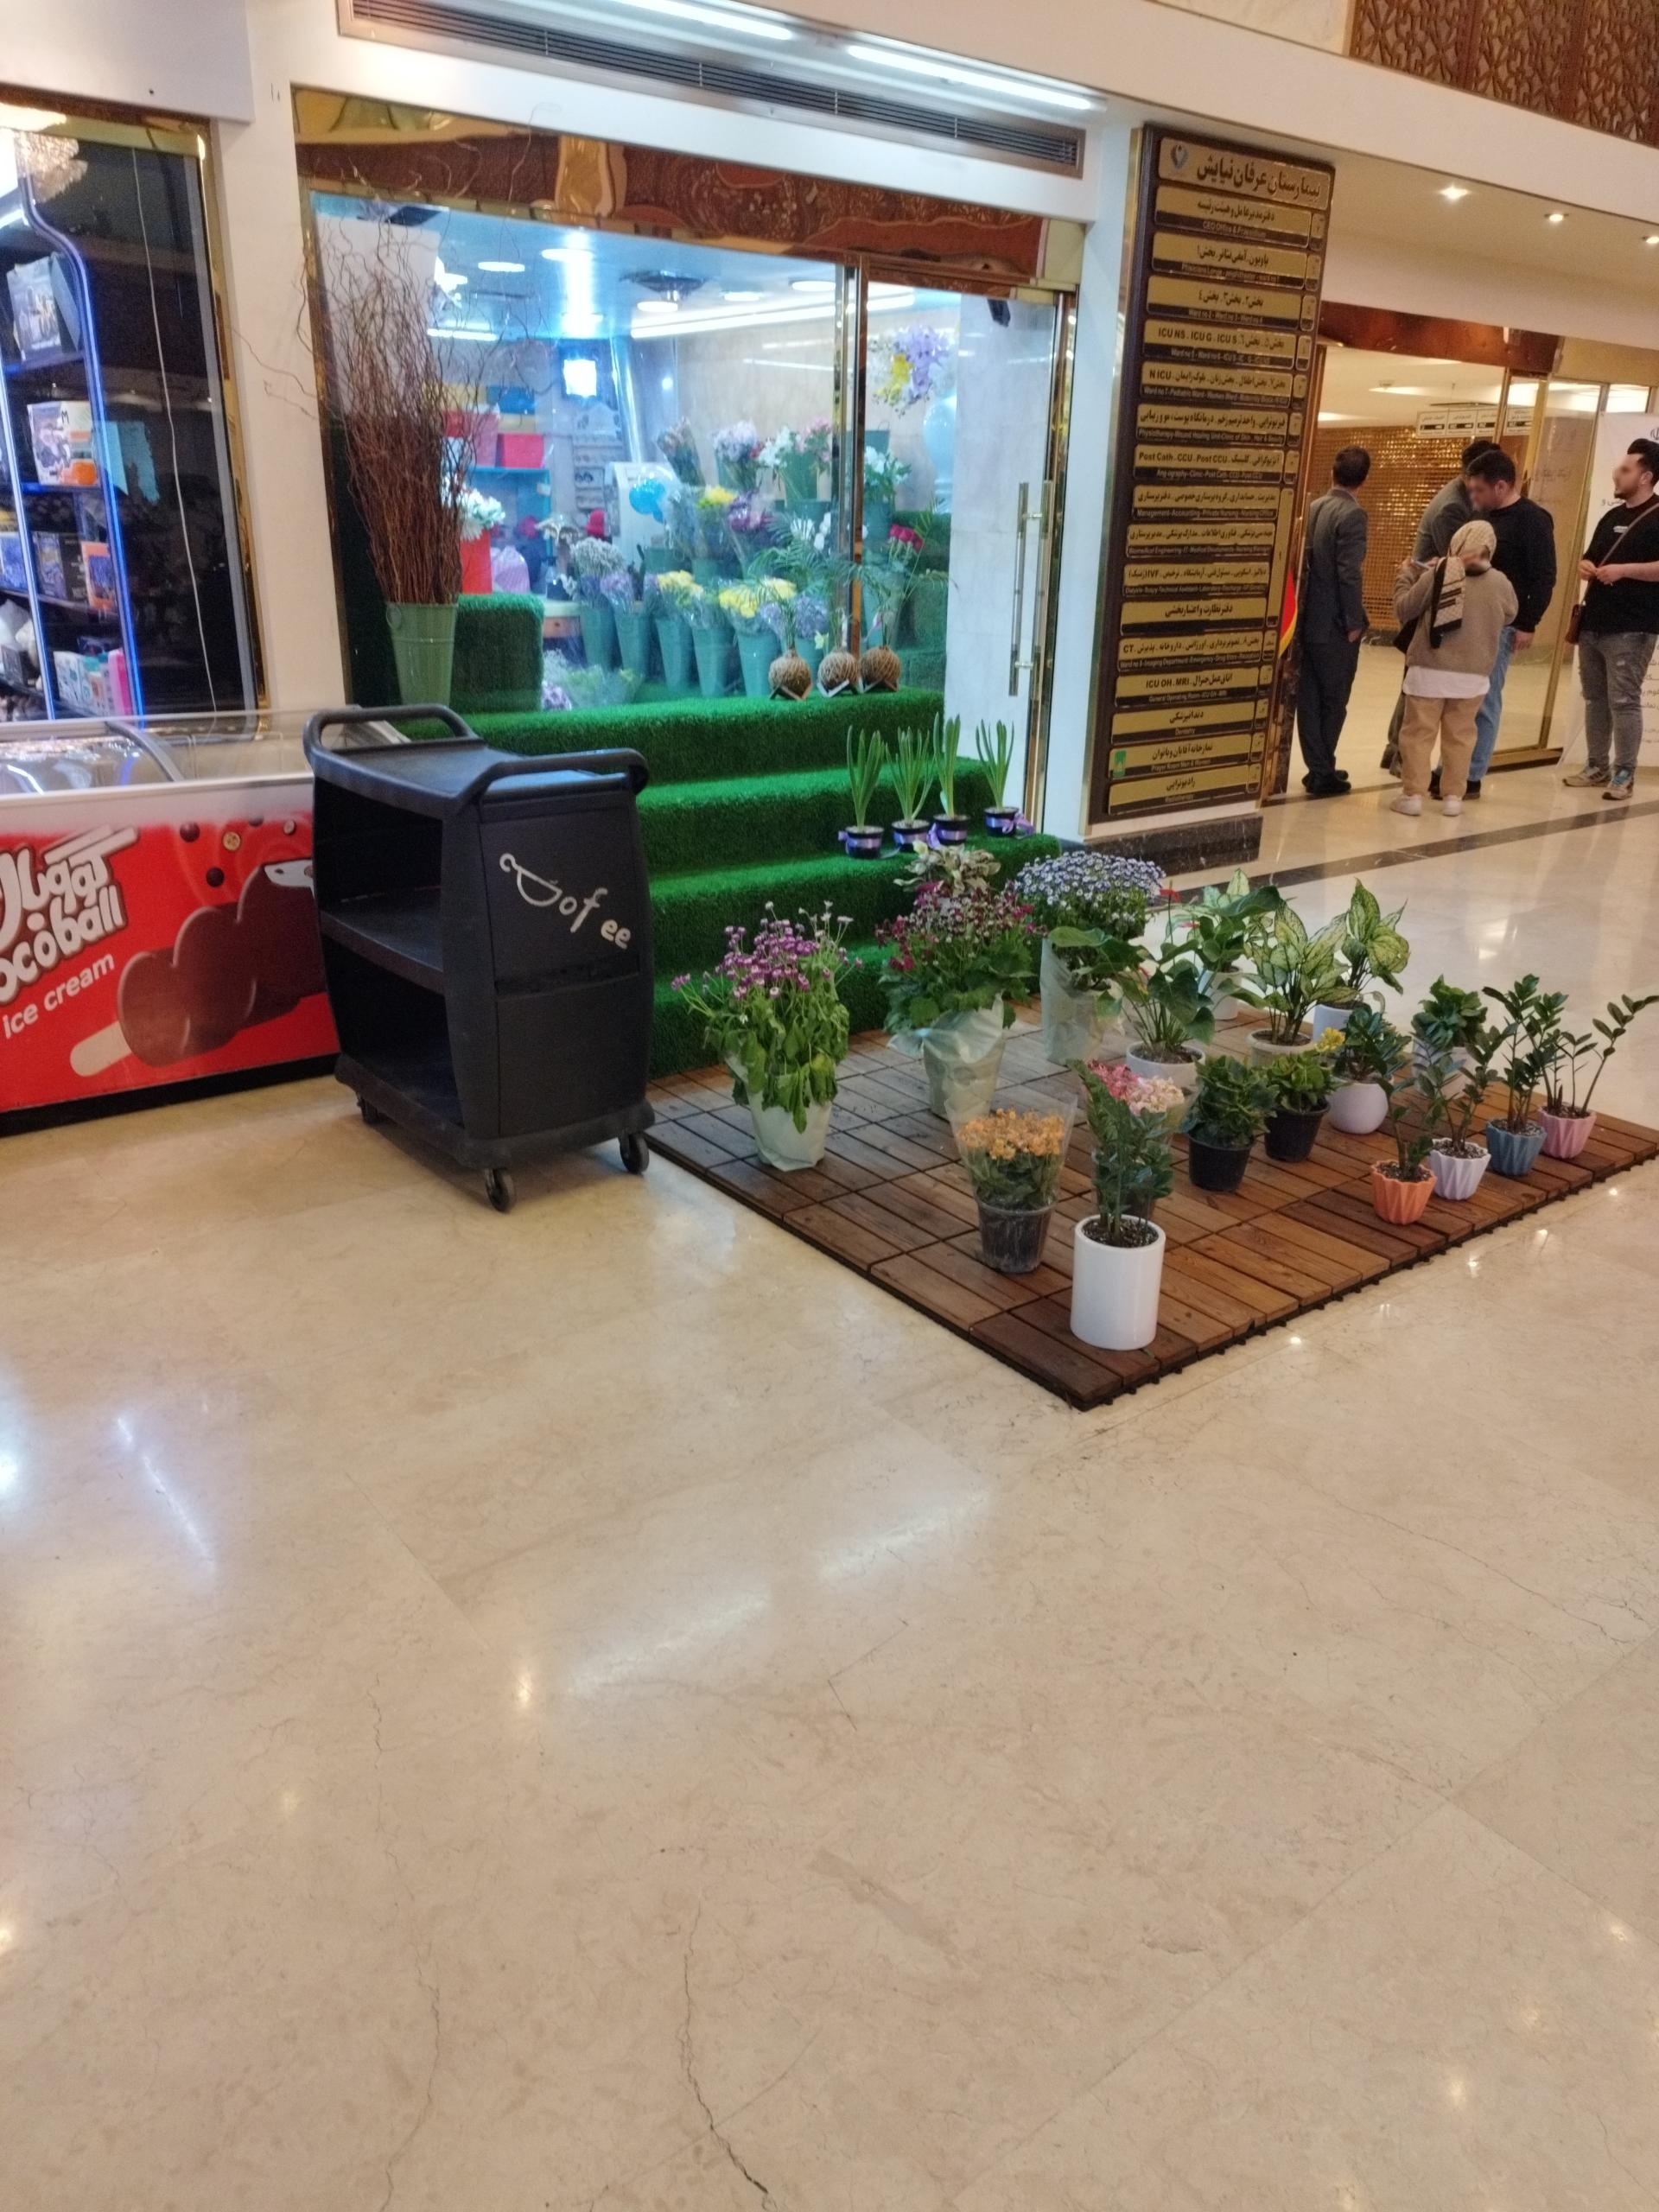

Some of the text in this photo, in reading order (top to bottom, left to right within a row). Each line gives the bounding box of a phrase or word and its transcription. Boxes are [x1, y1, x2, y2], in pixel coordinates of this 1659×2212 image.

[1196, 154, 1321, 201] بیمارستان عرفان نیایش
[1158, 327, 1185, 340] ICU NS
[1191, 330, 1205, 341] ICU
[1216, 334, 1231, 345] ICU
[1157, 369, 1172, 381] ICU
[1139, 452, 1155, 461] Post
[1177, 453, 1193, 462] CCU
[1197, 454, 1228, 463] Post CCU
[1123, 644, 1135, 653] CT
[1146, 678, 1173, 689] ICU OH
[1176, 677, 1190, 687] MRI
[1170, 709, 1205, 724] دندانپزشکی
[3, 953, 115, 1039] ice cream
